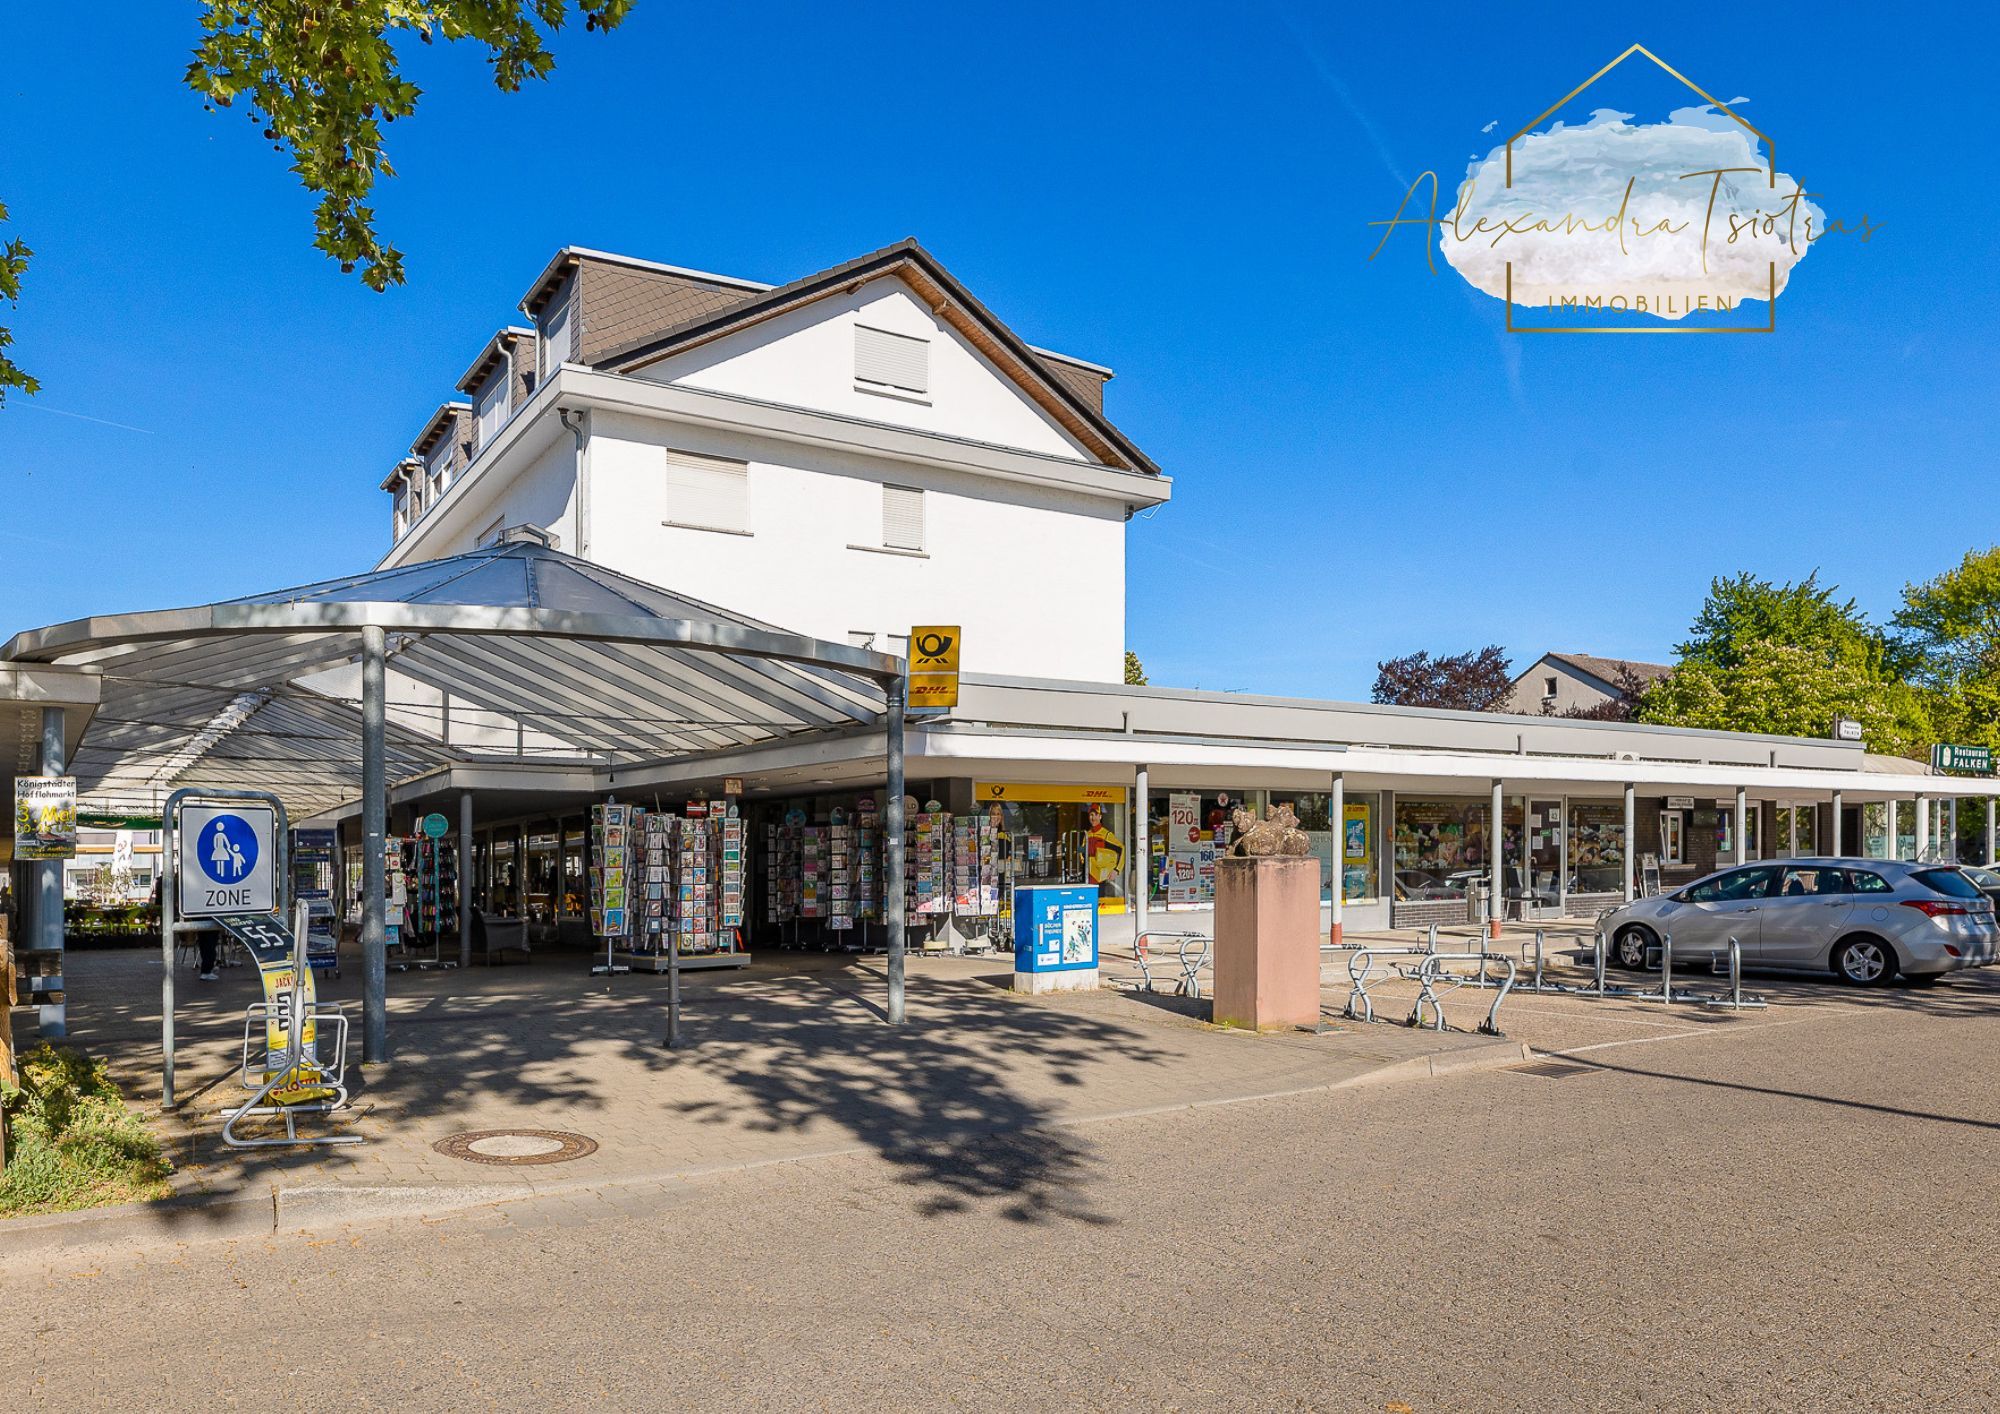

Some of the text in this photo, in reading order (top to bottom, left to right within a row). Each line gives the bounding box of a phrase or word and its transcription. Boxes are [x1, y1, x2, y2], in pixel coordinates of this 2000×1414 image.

[914, 686, 949, 695] DHL
[1954, 746, 1989, 758] Restaurant
[1953, 757, 1988, 769] FALKEN
[1085, 790, 1110, 798] DHL
[41, 805, 76, 823] Mai
[205, 889, 251, 907] ZONE
